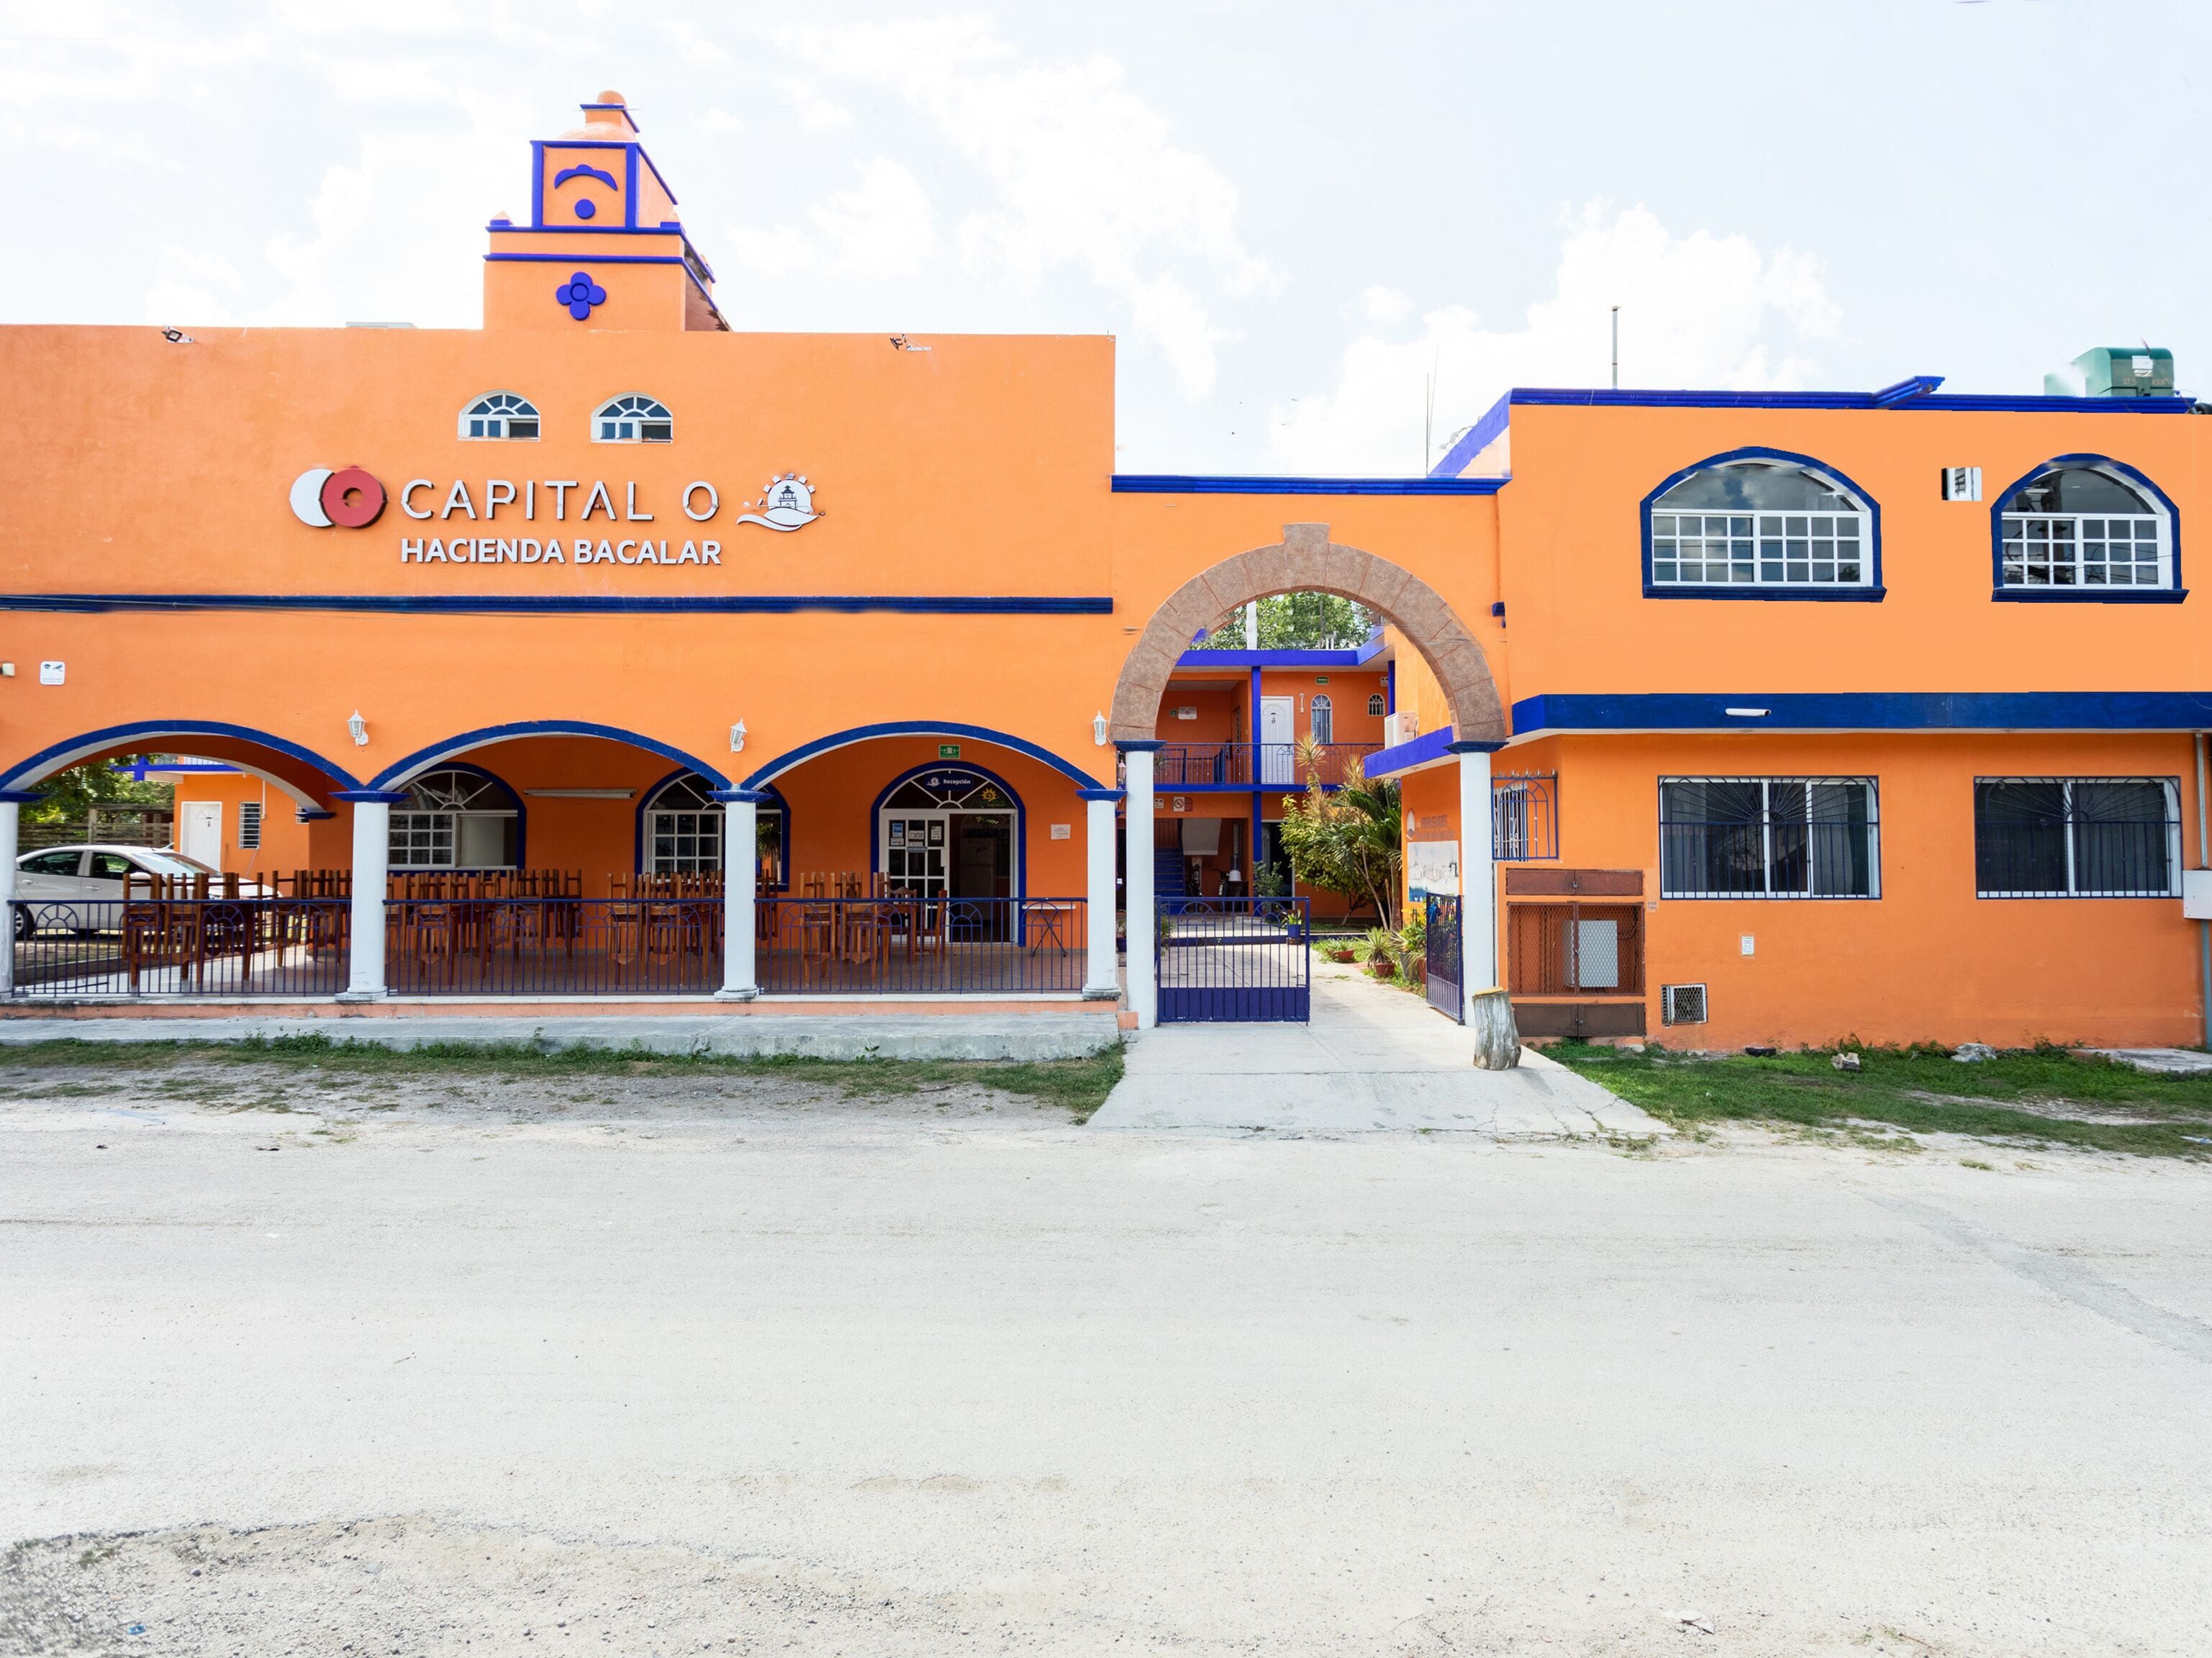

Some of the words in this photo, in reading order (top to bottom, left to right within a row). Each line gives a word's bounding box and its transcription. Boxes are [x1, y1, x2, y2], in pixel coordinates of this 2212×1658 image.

[401, 479, 654, 521] CAPITAL
[683, 481, 720, 522] O
[401, 538, 566, 564] HACIENDA
[574, 539, 722, 566] BACALAR
